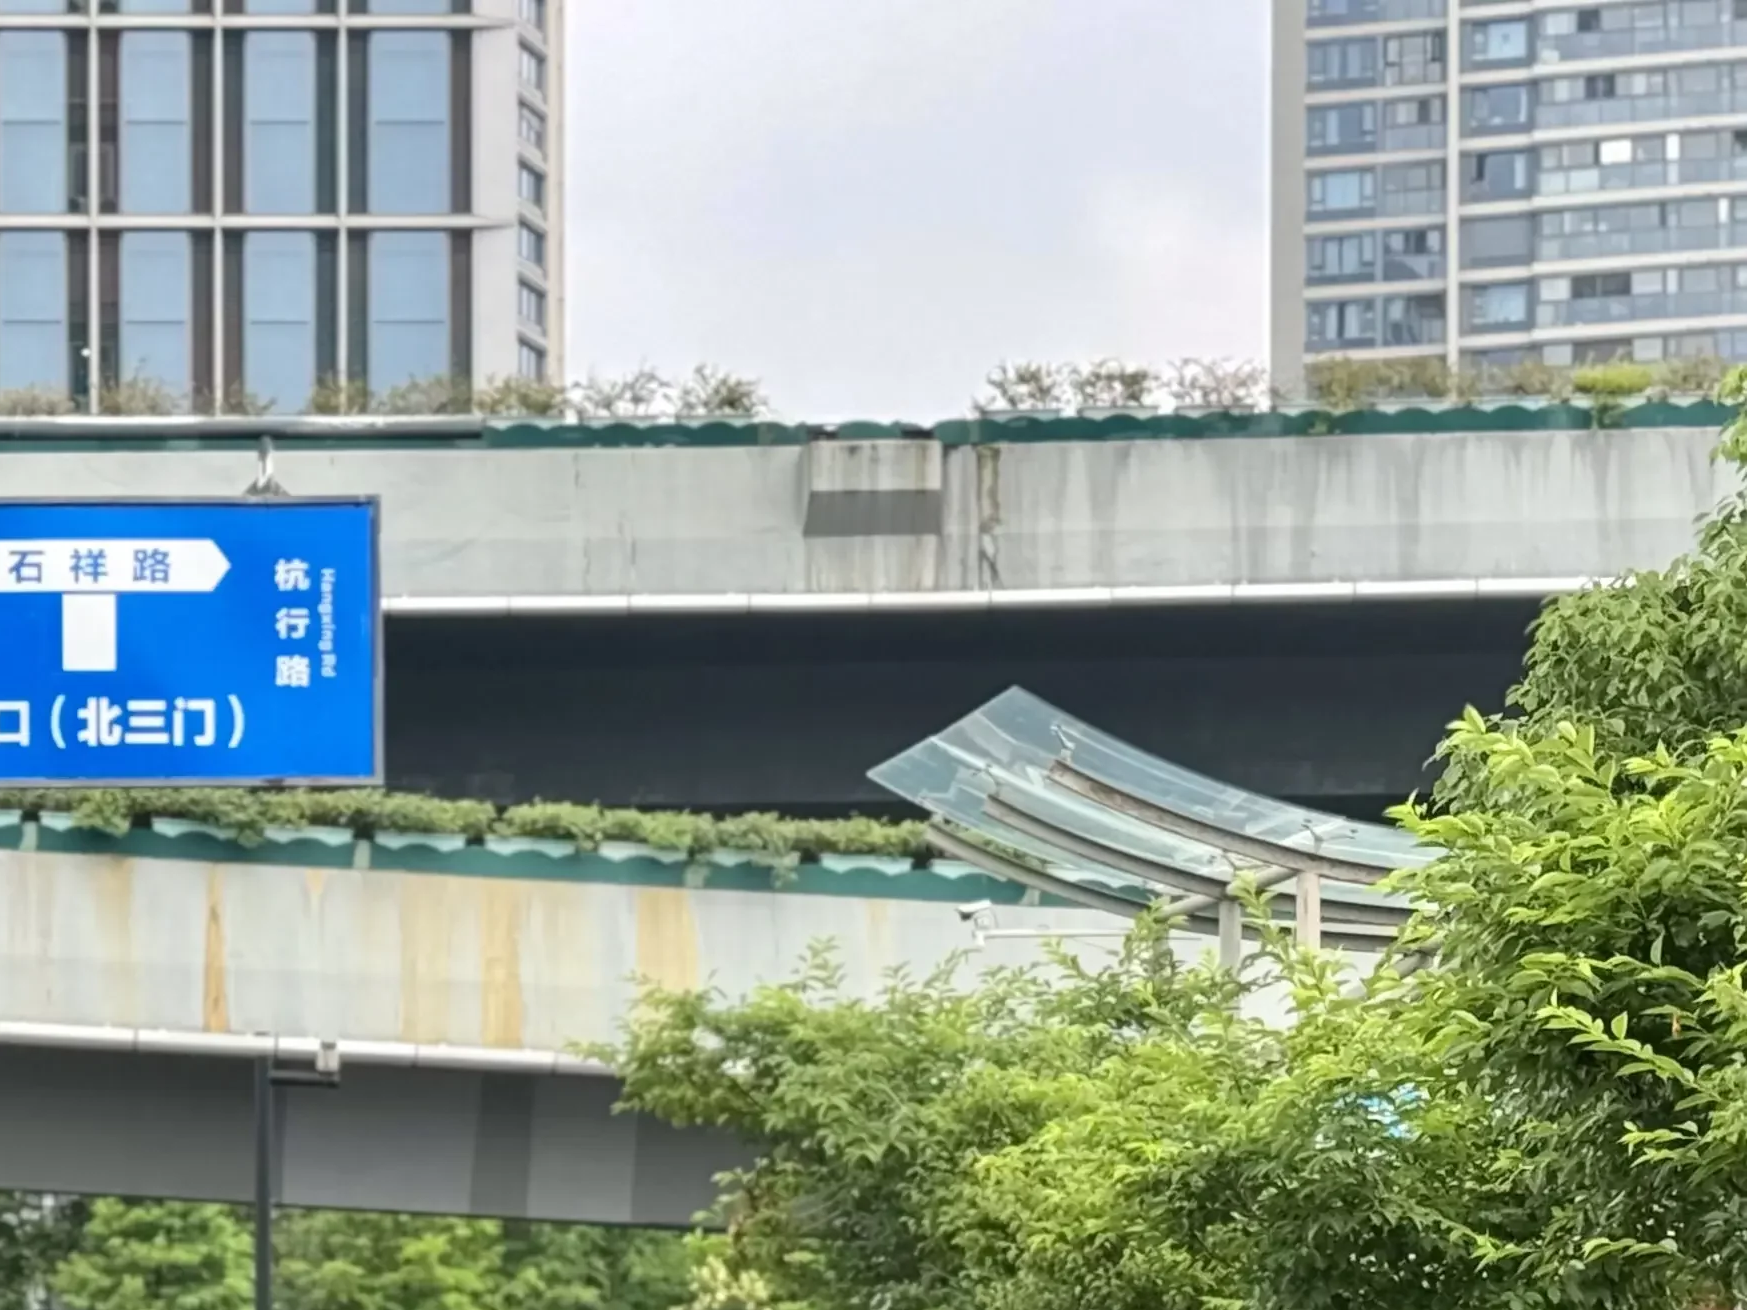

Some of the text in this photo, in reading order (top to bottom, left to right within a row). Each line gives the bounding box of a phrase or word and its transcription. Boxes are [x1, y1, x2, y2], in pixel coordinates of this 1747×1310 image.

[8, 548, 171, 584] 石祥路
[274, 558, 311, 688] 杭行路
[317, 567, 337, 678] Hangxing Rd
